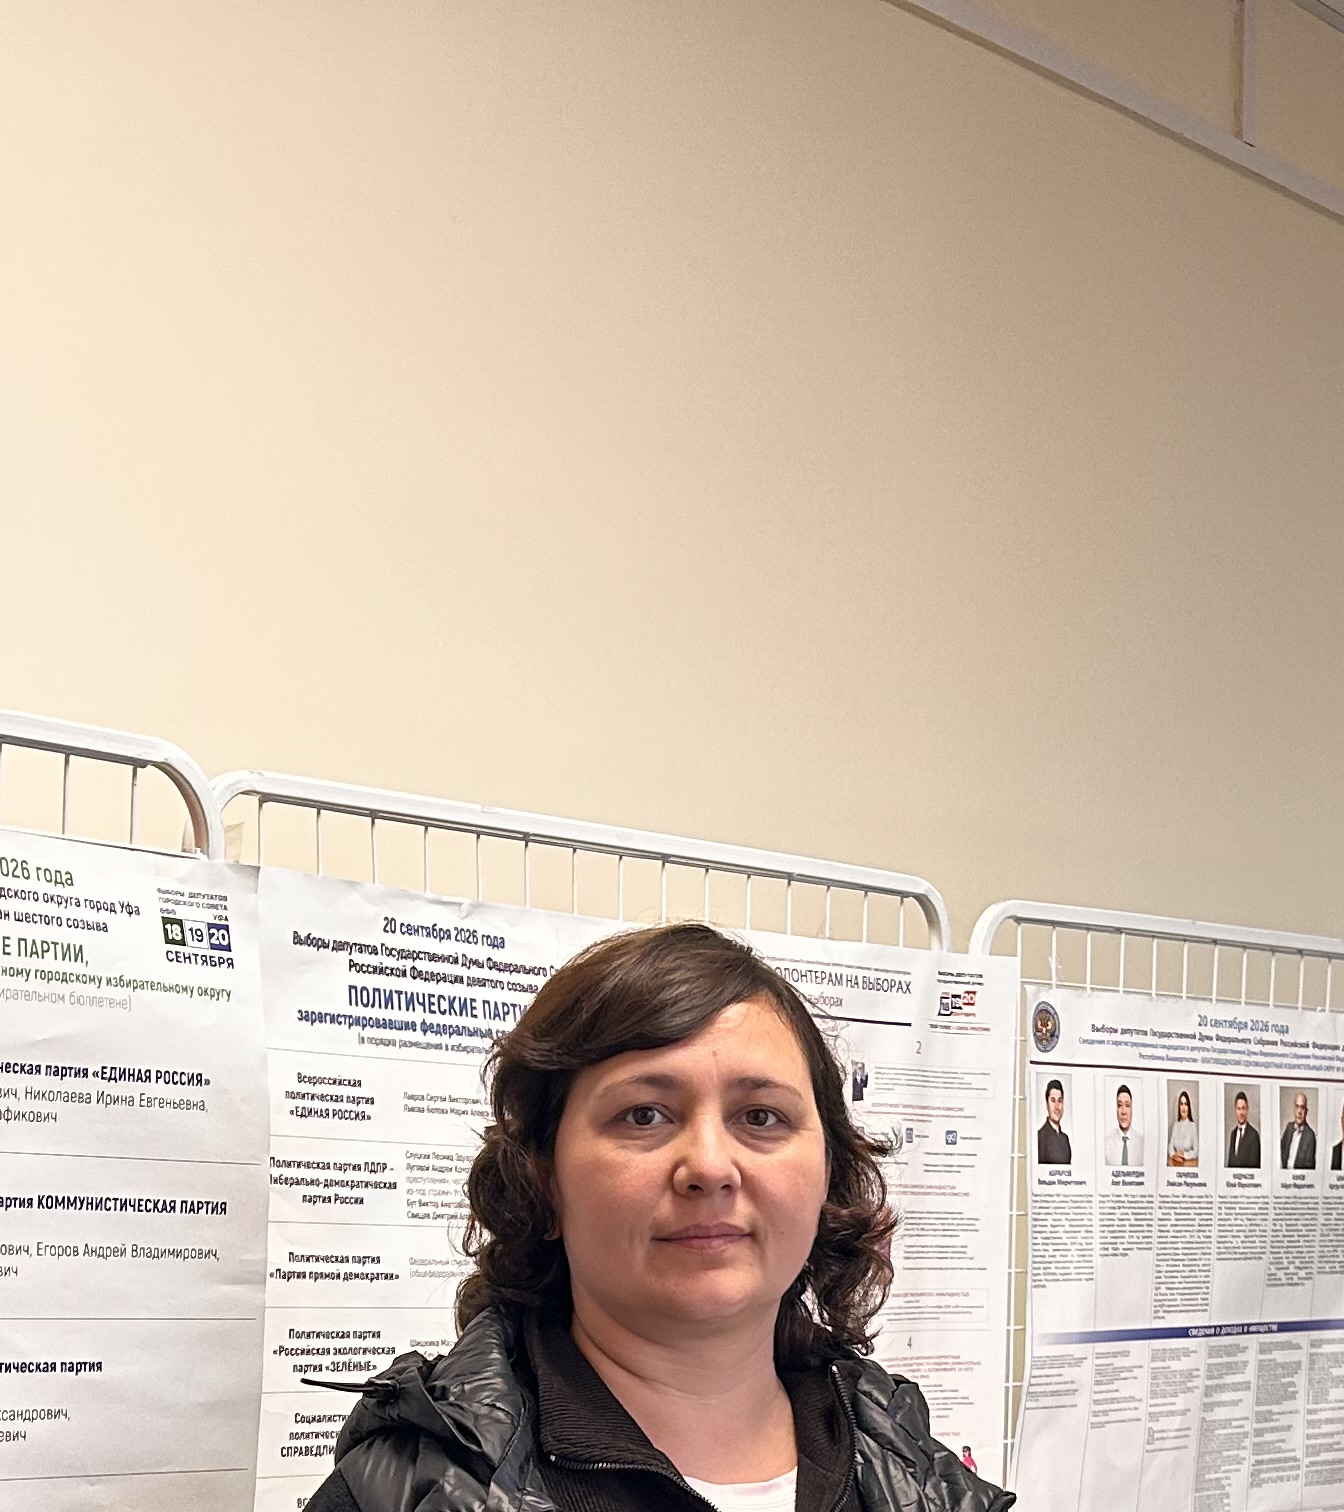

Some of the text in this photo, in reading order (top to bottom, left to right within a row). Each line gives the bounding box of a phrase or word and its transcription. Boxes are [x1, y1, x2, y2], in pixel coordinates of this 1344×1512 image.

[36, 866, 74, 888] года
[43, 893, 81, 909] округа
[84, 898, 117, 915] город
[118, 900, 141, 918] Уфа
[14, 911, 62, 928] шестого
[66, 917, 108, 932] созыва
[164, 923, 229, 946] 18 19 20
[383, 916, 505, 950] 20 сентября 2026 года
[17, 937, 89, 967] ПАРТИИ,
[293, 930, 330, 951] Выборы
[331, 940, 378, 955] депутатов
[380, 943, 458, 964] Государственной
[166, 950, 234, 969] СЕНТЯБРЯ
[349, 959, 407, 978] Российской
[410, 965, 464, 985] Федерации
[35, 968, 102, 989] городскому
[106, 975, 194, 998] избирательному
[197, 985, 232, 1002] округу
[846, 974, 912, 994] НА ВЫБОРАХ
[69, 991, 132, 1012] бюллетене)
[348, 985, 478, 1019] ПОЛИТИЧЕСКИЕ
[297, 1009, 417, 1032] зарегистрировавшие
[1198, 1014, 1290, 1036] 20 сентября 2026 года
[915, 1040, 922, 1054] 2
[45, 1063, 88, 1081] партия
[91, 1065, 152, 1083] «ЕДИНАЯ
[155, 1070, 211, 1087] РОССИЯ»
[297, 1072, 362, 1088] Всероссийская
[25, 1086, 92, 1104] Николаева
[96, 1090, 135, 1108] Ирина
[139, 1093, 208, 1113] Евгеньевна,
[285, 1091, 344, 1103] политическая
[289, 1106, 371, 1122] «ЕДИНАЯ РОССИЯ»
[270, 1157, 387, 1174] Политическая партия ЛДПР
[37, 1194, 176, 1214] КОММУНИСТИЧЕСКАЯ
[180, 1200, 227, 1216] ПАРТИЯ
[302, 1193, 364, 1206] партия России
[37, 1242, 79, 1260] Егоров
[83, 1243, 127, 1261] Андрей
[131, 1244, 220, 1262] Владимирович,
[289, 1252, 381, 1266] Политическая партия
[289, 1328, 381, 1341] Политическая партия
[60, 1361, 103, 1376] партия
[293, 1364, 323, 1375] партия
[281, 1445, 336, 1457] СПРАВЕДЛИ
